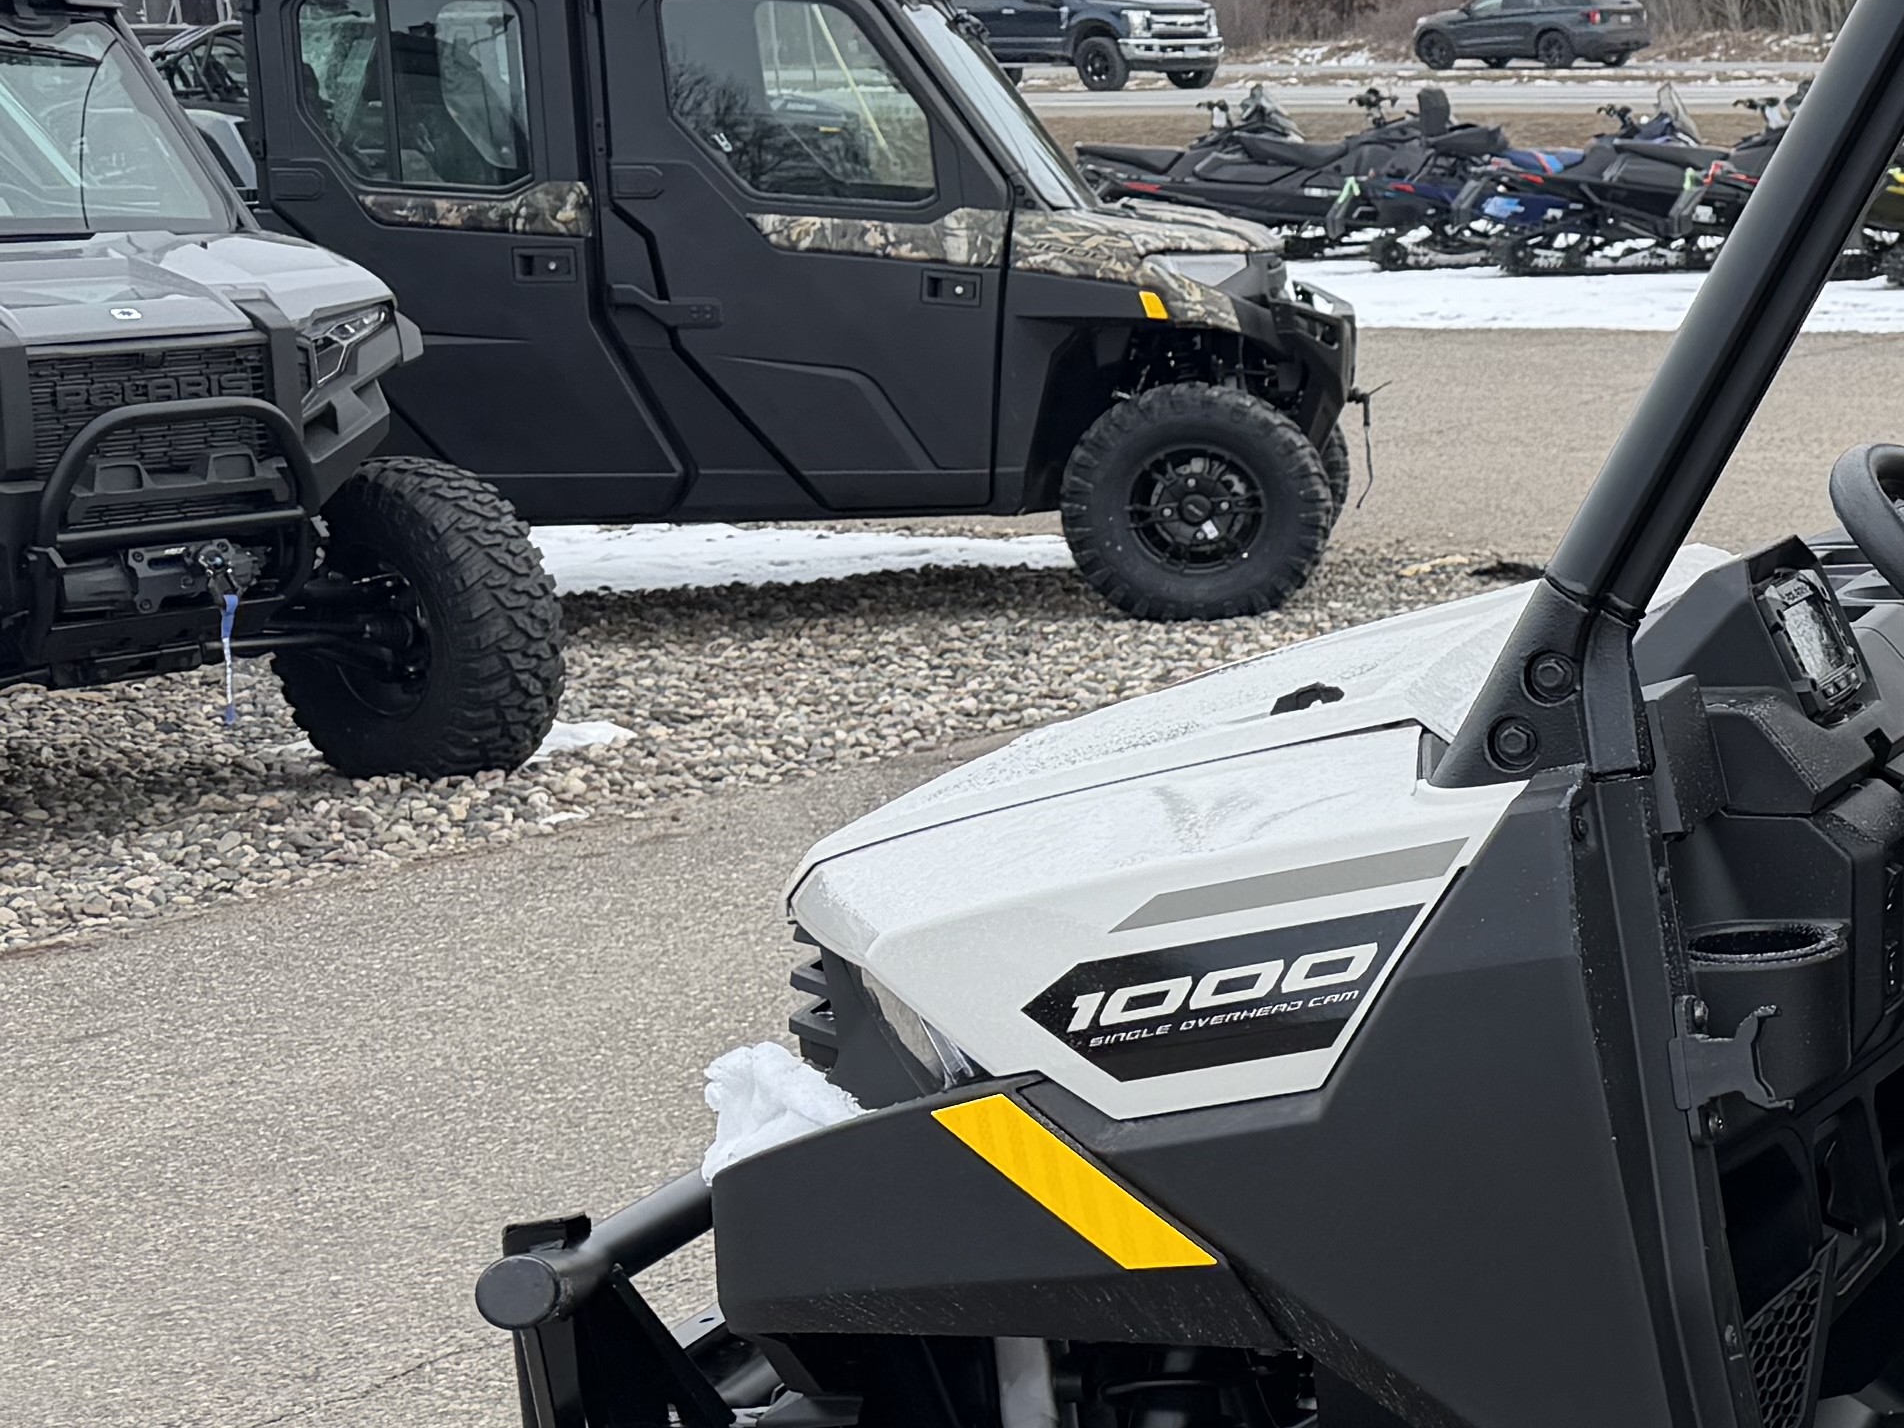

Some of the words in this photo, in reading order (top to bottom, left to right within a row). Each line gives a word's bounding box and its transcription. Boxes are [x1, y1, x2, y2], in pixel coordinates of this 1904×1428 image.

[55, 373, 252, 412] POLARIS
[1066, 942, 1379, 1033] 1000
[1089, 1023, 1173, 1048] SINGLE
[1179, 1000, 1304, 1032] OVERHEAD
[1307, 989, 1359, 1008] CAM
